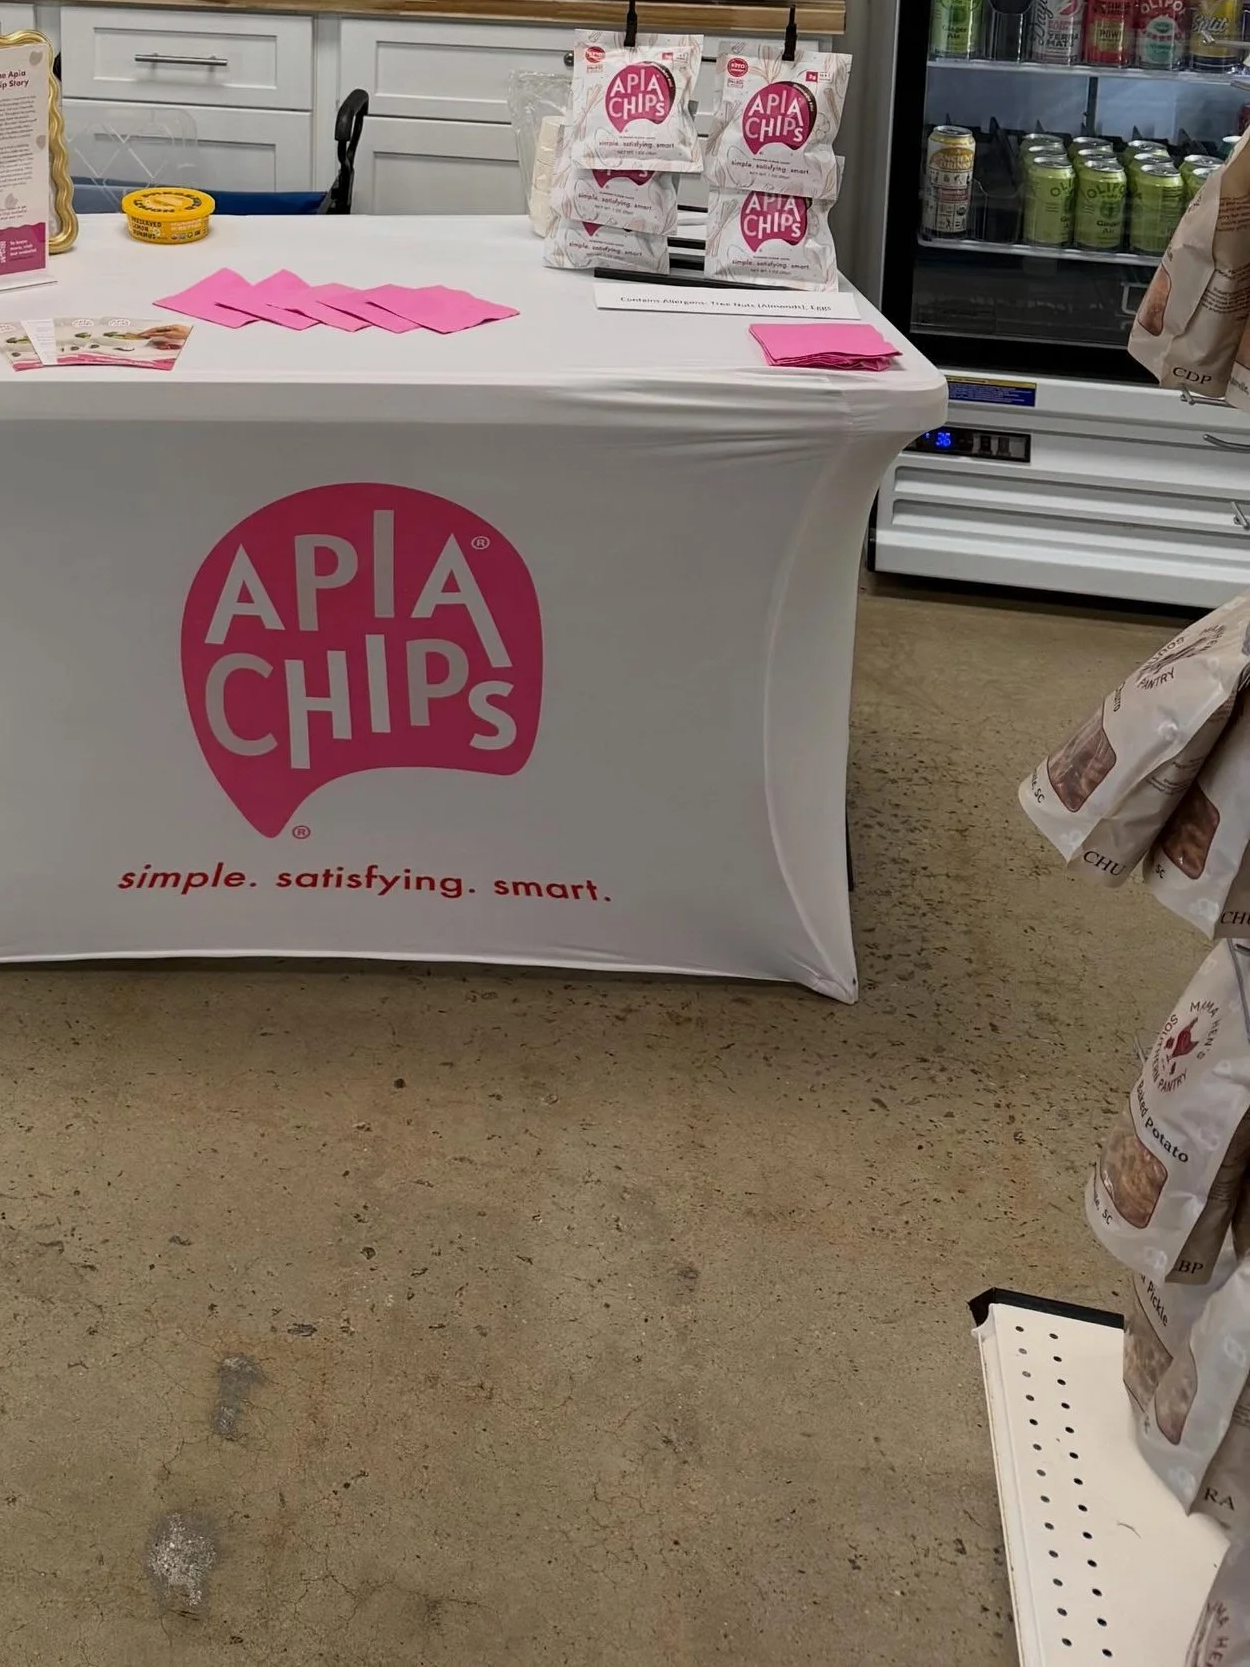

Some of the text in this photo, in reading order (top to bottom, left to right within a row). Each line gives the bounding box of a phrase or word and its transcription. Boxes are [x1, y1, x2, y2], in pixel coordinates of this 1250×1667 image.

[8, 70, 26, 79] Apia
[10, 79, 29, 88] Story
[610, 69, 664, 101] APIA
[609, 93, 665, 120] CHIPS
[748, 90, 804, 127] APIA
[745, 115, 804, 142] CHIPS
[746, 193, 801, 222] APIA
[743, 212, 801, 239] CHIPS
[620, 295, 660, 304] Contains
[1173, 367, 1212, 384] CDP
[204, 509, 513, 669] APIA
[1137, 667, 1175, 690] PANTRY
[204, 633, 518, 770] CHIPS
[1082, 850, 1127, 877] CHU
[117, 863, 612, 903] simple. satisfying. smart.
[1190, 997, 1220, 1019] MAMA
[1157, 1068, 1188, 1095] PANTRY
[1144, 1117, 1190, 1164] Potato
[1146, 1278, 1170, 1328] Pickle
